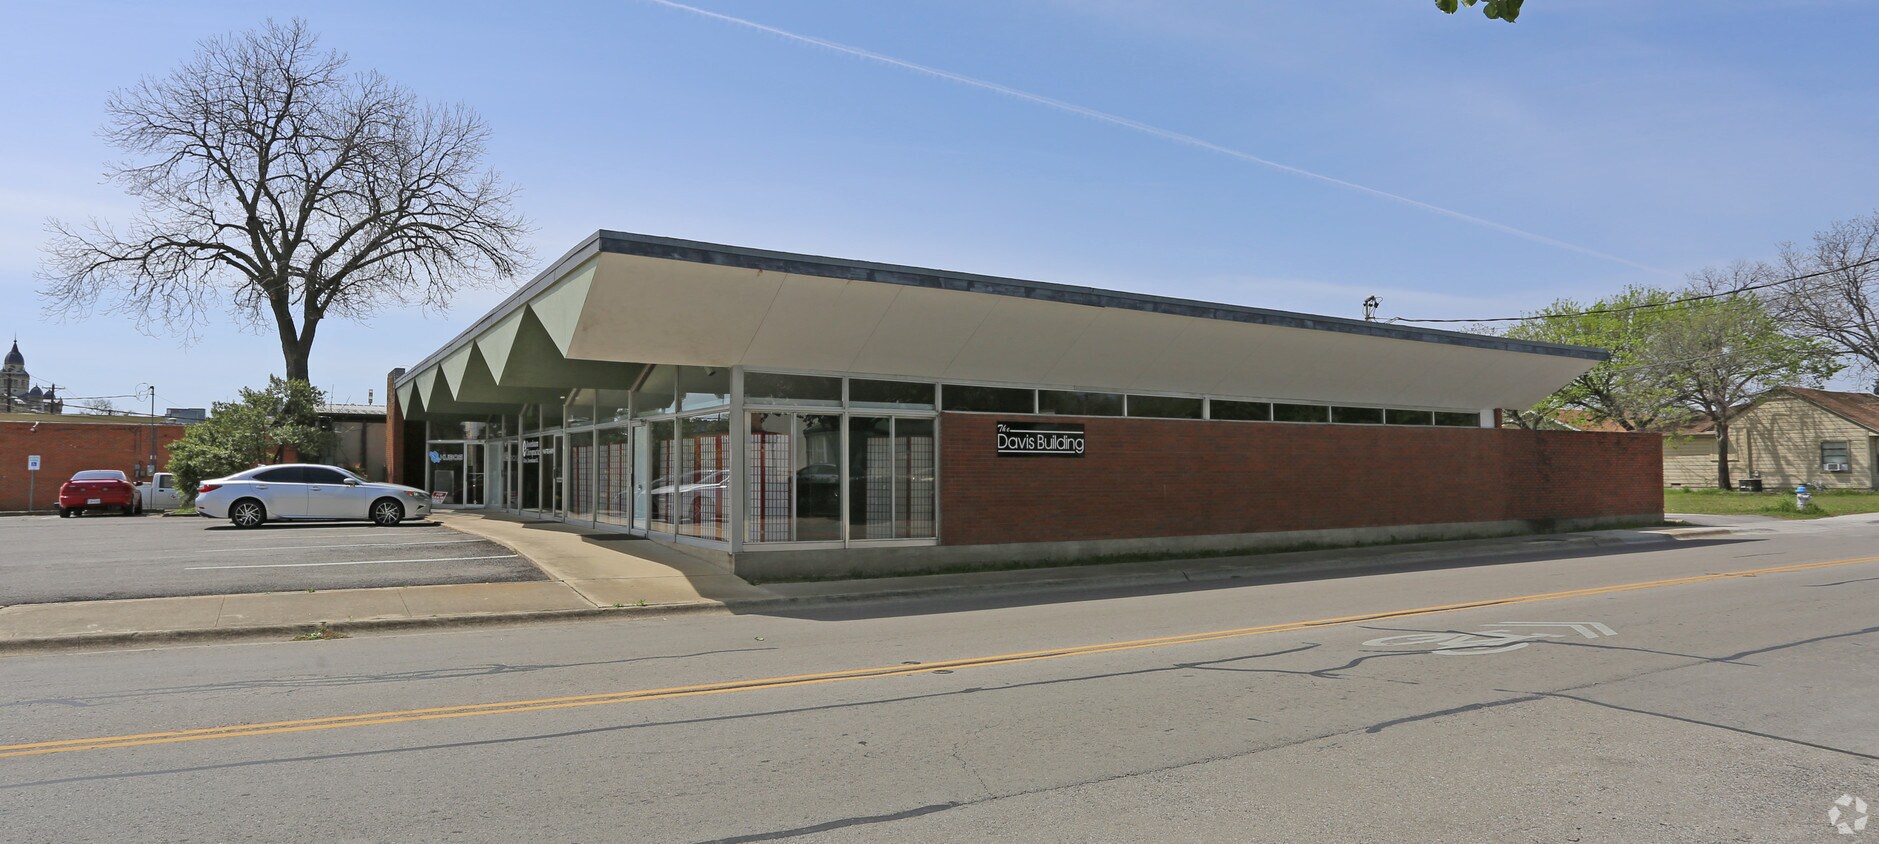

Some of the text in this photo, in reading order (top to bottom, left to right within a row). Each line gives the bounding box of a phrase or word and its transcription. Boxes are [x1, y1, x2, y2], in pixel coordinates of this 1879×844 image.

[997, 424, 1010, 433] The
[997, 433, 1085, 454] Davis Building
